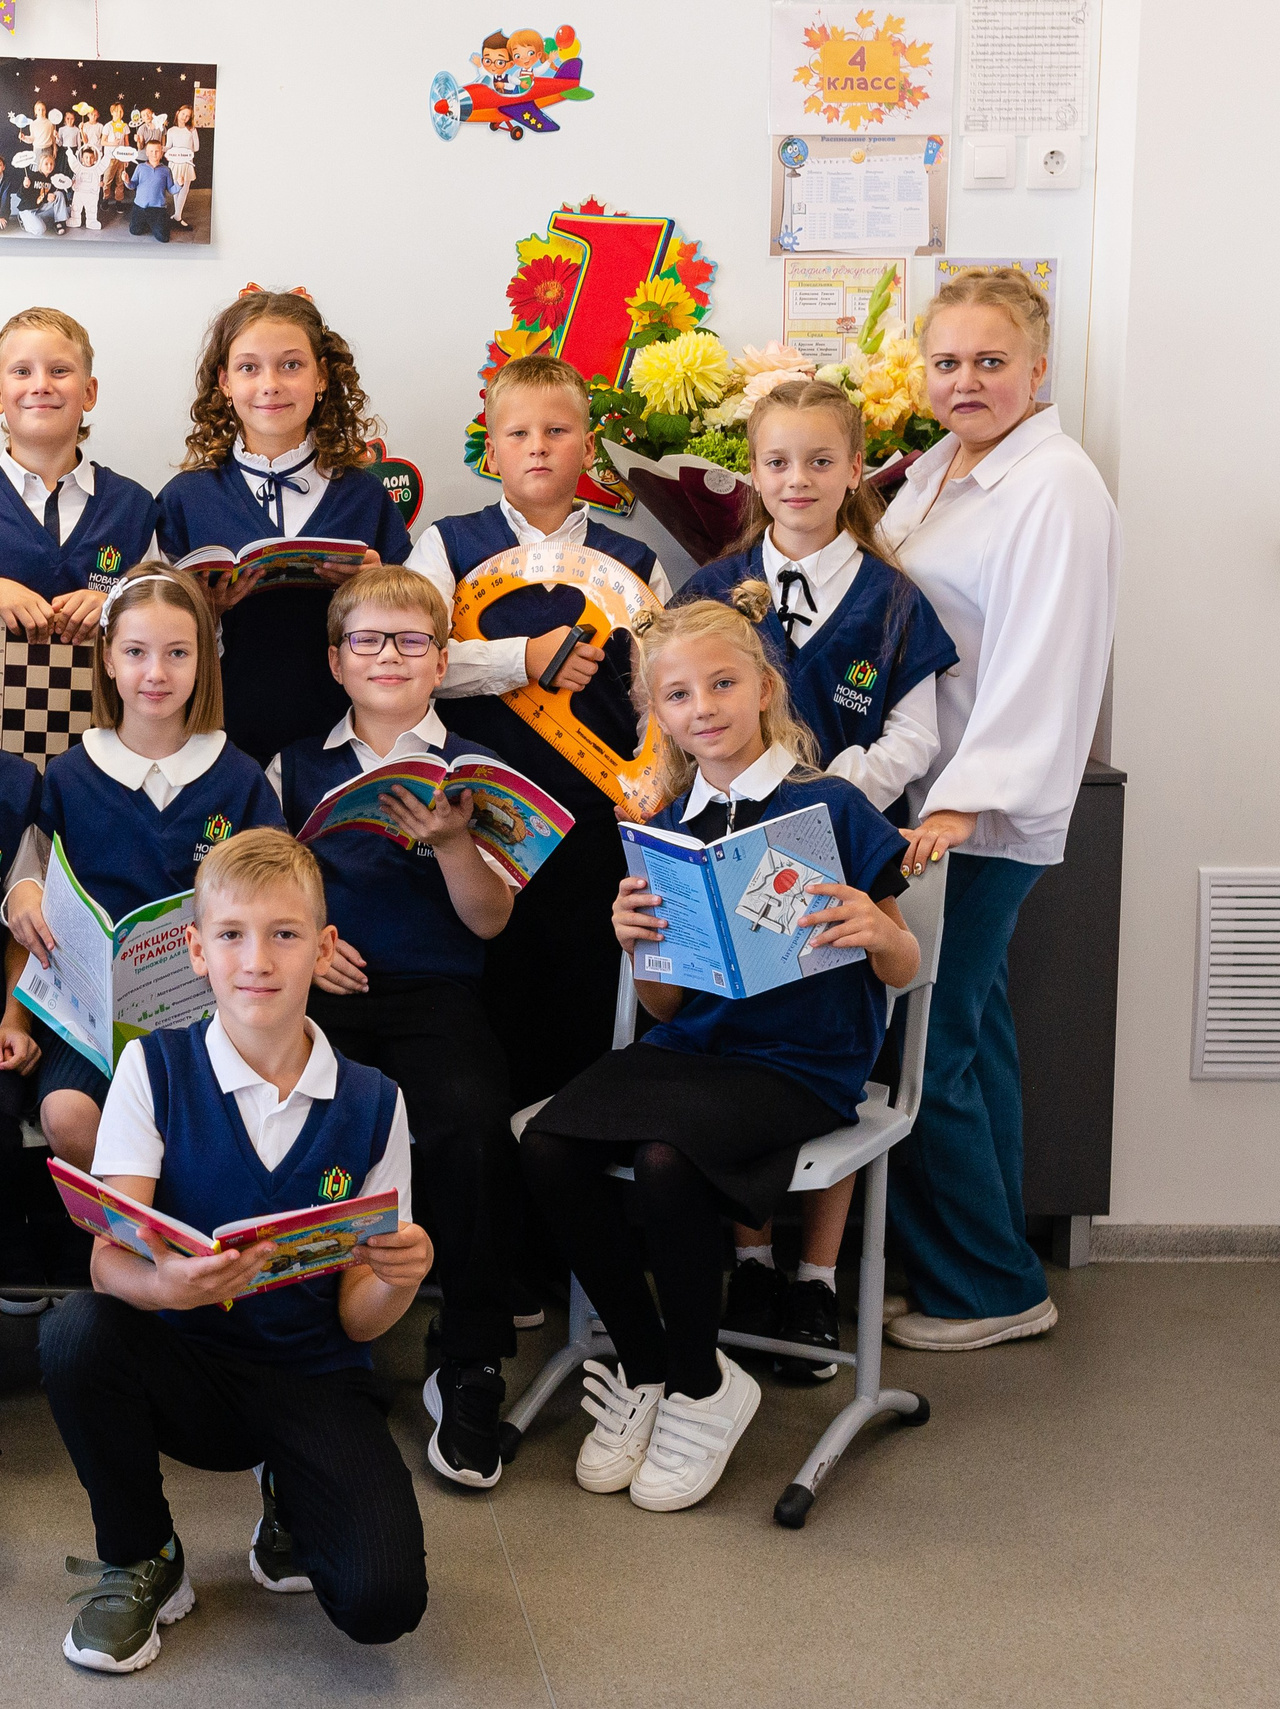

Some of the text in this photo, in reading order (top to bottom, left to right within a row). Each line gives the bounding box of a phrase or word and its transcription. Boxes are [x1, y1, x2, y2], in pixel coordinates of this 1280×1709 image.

[848, 45, 866, 72] 4
[827, 76, 896, 91] класс
[88, 582, 111, 593] ШКОЛ
[89, 572, 120, 586] НОВАЯ
[471, 580, 479, 590] 20
[490, 567, 499, 576] 30
[511, 557, 520, 566] 40
[577, 556, 586, 565] 70
[598, 565, 608, 575] 80
[612, 581, 625, 595] 90
[633, 593, 646, 606] 100
[459, 604, 470, 616] 170
[474, 589, 486, 600] 160
[491, 577, 504, 588] 150
[510, 569, 523, 579] 140
[531, 565, 544, 573] 130
[552, 565, 565, 573] 120
[571, 568, 585, 578] 110
[592, 576, 605, 587] 100
[833, 693, 867, 715] ШКОЛА
[836, 684, 872, 706] НОВАЯ
[532, 710, 541, 719] 25
[555, 730, 563, 739] 30
[577, 750, 585, 759] 35
[600, 770, 608, 779] 40
[623, 791, 631, 800] 45
[732, 847, 742, 862] 4
[135, 951, 181, 975] Тренажёр для
[153, 965, 190, 984] грамотность
[171, 992, 206, 1006] Финансовая
